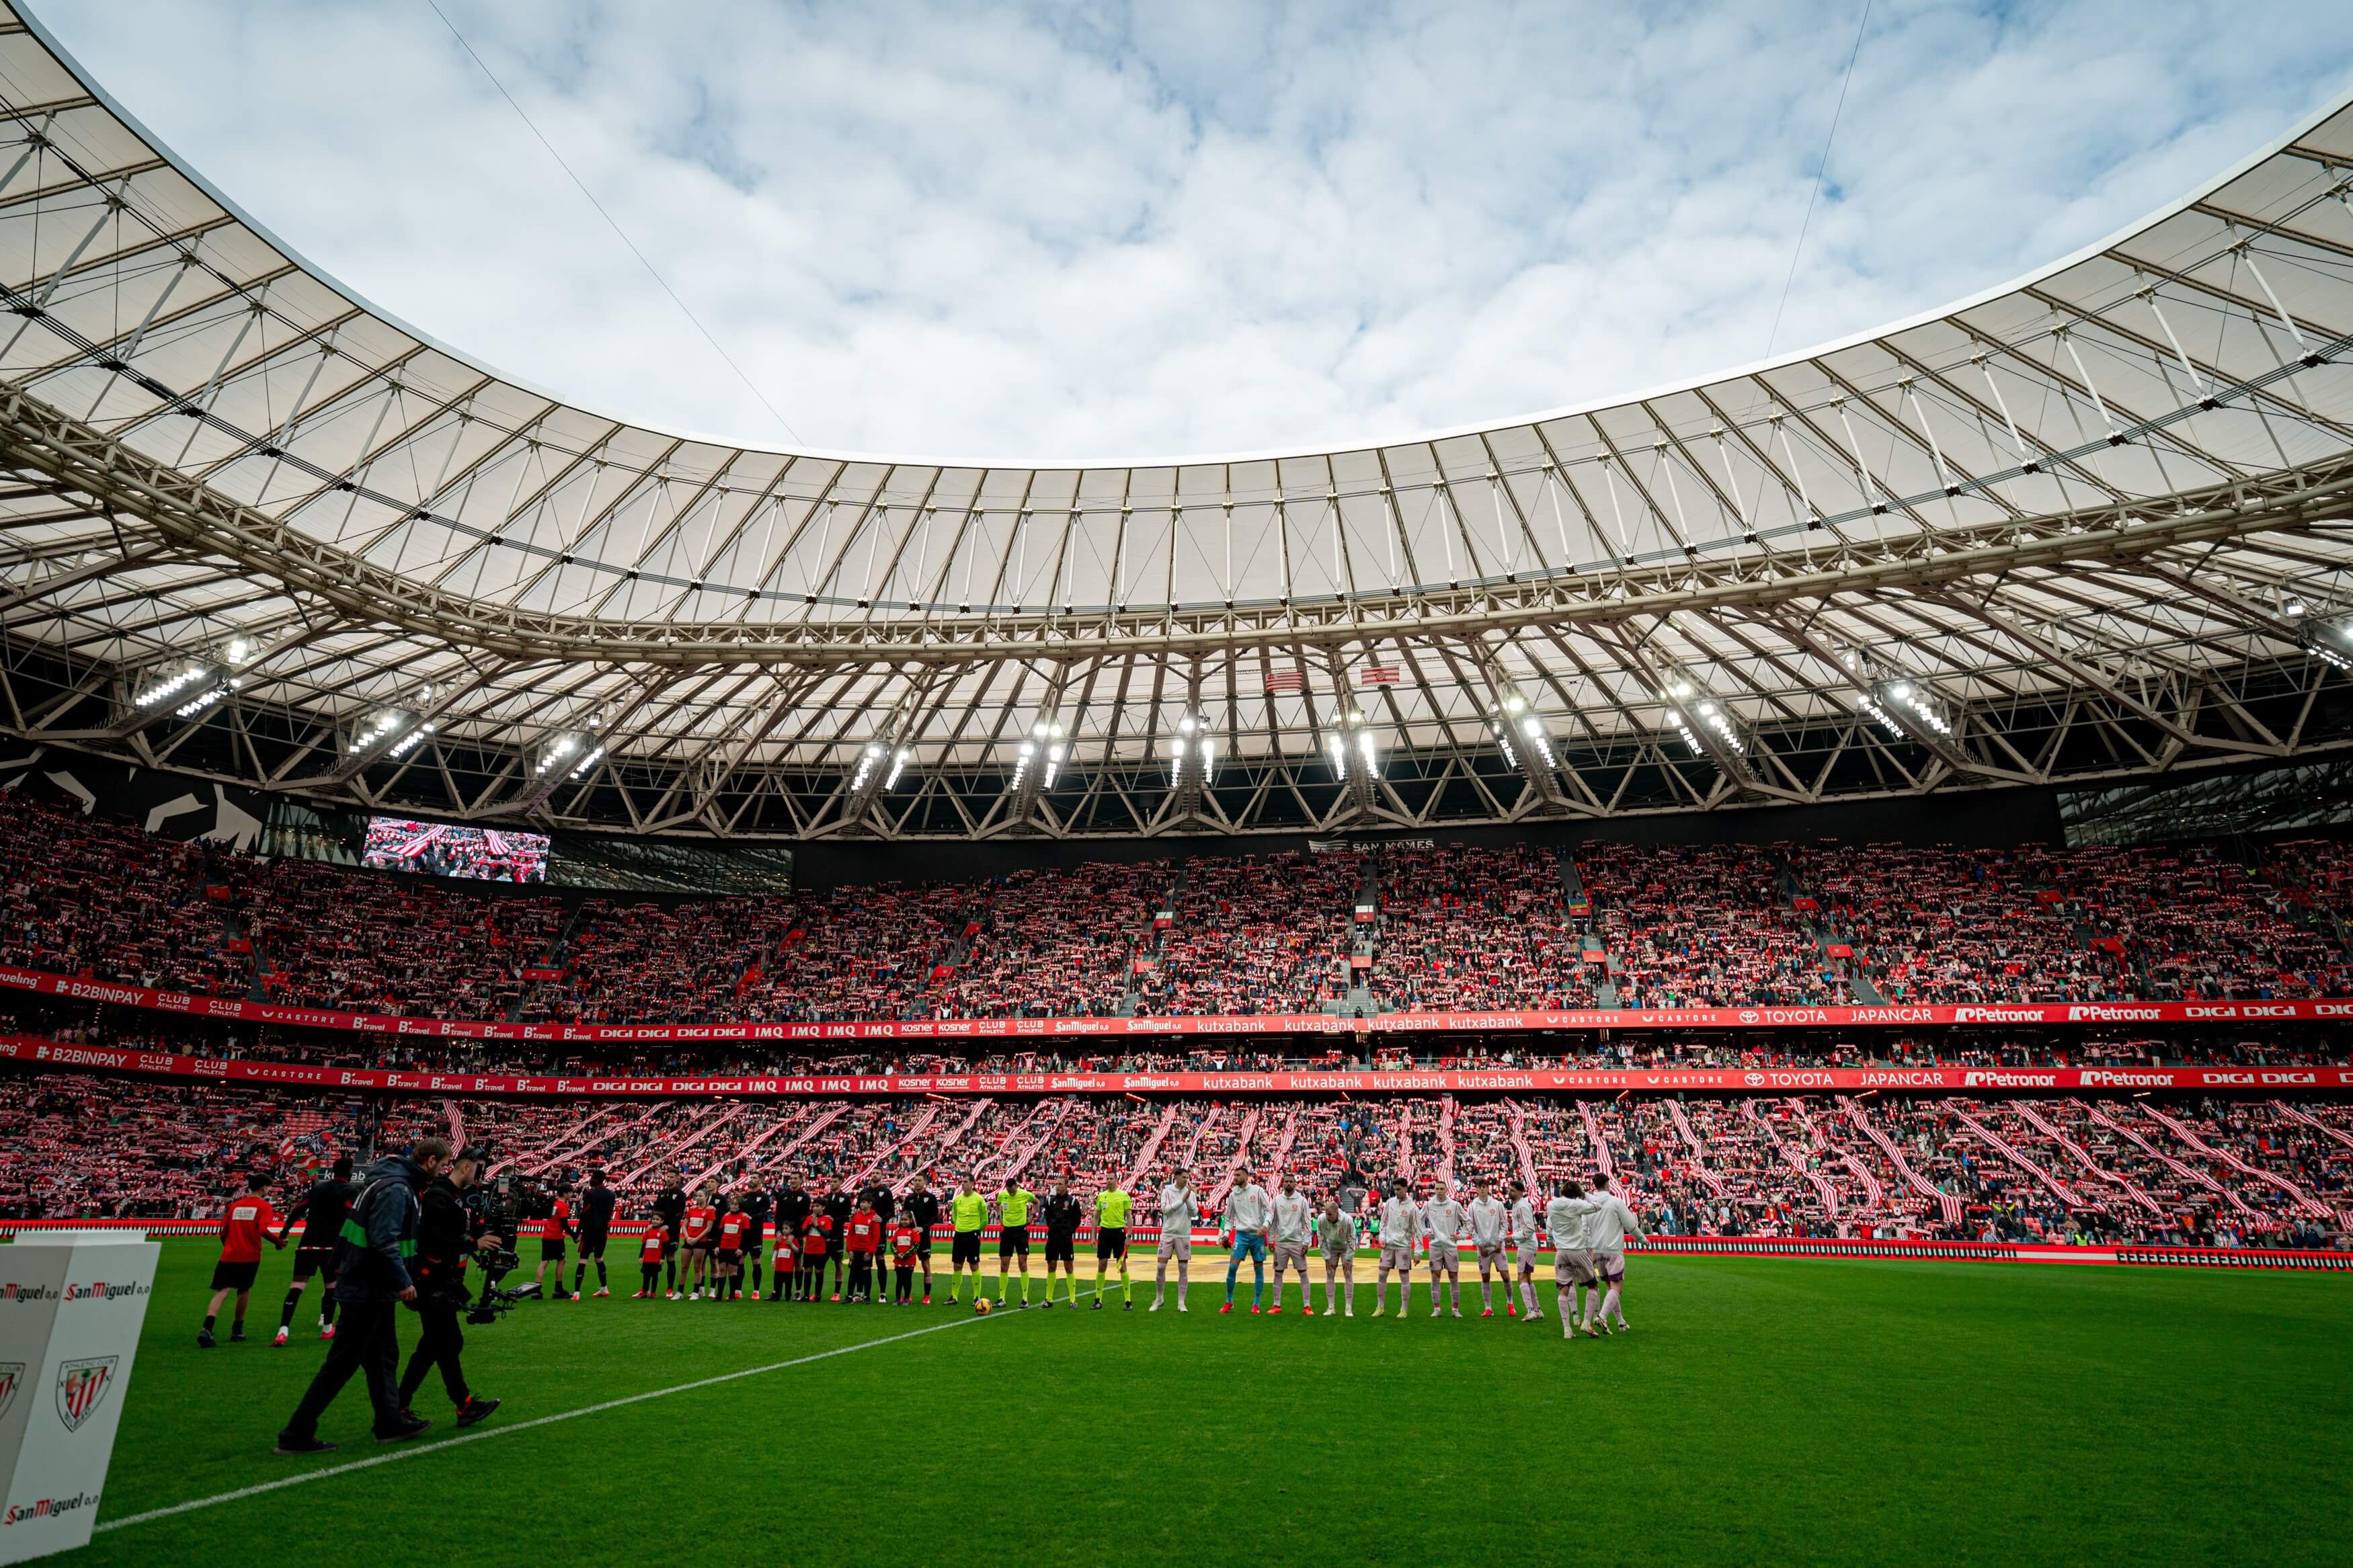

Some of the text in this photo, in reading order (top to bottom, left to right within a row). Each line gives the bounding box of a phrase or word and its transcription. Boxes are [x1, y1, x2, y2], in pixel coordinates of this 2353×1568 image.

[1353, 843, 1379, 852] SAN
[71, 983, 143, 1005] B2BINPAY
[157, 993, 190, 1005] CLUB
[156, 1001, 188, 1011] ATHLETIC
[209, 1000, 242, 1012] CLUB
[2243, 1005, 2297, 1016] DIGI
[2315, 1005, 2353, 1016] DIG
[208, 1008, 240, 1017] ATHLETIC
[1764, 1010, 1827, 1022] TOYOTA
[1851, 1009, 1933, 1022] JAPANCAR
[1976, 1008, 2044, 1022] Petronor
[2089, 1006, 2161, 1020] Petronor
[2185, 1007, 2237, 1017] DIGI
[278, 1012, 335, 1024] CASTORE
[1367, 1017, 1440, 1030] kutxabank
[1449, 1015, 1523, 1029] kutxabank
[1562, 1016, 1619, 1024] CASTORE
[1658, 1014, 1716, 1022] CASTORE
[865, 1025, 894, 1036] IMQ
[979, 1021, 1006, 1029] CLUB
[1197, 1020, 1266, 1032] kutxabank
[1285, 1019, 1355, 1032] kutxabank
[600, 1030, 633, 1038] DIGI
[637, 1030, 670, 1038] DIGI
[677, 1028, 710, 1037] DIGI
[713, 1028, 746, 1036] DIGI
[755, 1027, 784, 1038] IMQ
[791, 1026, 820, 1037] IMQ
[827, 1026, 856, 1037] IMQ
[52, 1048, 127, 1067] B2BINPAY
[140, 1055, 173, 1065] CLUB
[138, 1063, 171, 1071] ATHLETIC
[194, 1060, 227, 1070] CLUB
[194, 1067, 225, 1076] ATHLETIC
[263, 1069, 322, 1080] CASTORE
[1203, 1075, 1273, 1089] kutxabank
[1291, 1075, 1362, 1088] kutxabank
[1373, 1075, 1447, 1088] kutxabank
[1458, 1074, 1533, 1087] kutxabank
[1569, 1076, 1627, 1084] CASTORE
[1770, 1073, 1834, 1085] TOYOTA
[1861, 1073, 1944, 1085] JAPANCAR
[1986, 1071, 2056, 1086] Petronor
[2102, 1071, 2174, 1085] Petronor
[2202, 1073, 2255, 1083] DIGI
[2261, 1073, 2316, 1083] DIGI
[592, 1082, 626, 1091] DIGI
[630, 1082, 664, 1091] DIGI
[672, 1082, 705, 1091] DIGI
[709, 1082, 742, 1091] DIGI
[748, 1081, 778, 1092] IMQ
[785, 1080, 814, 1092] IMQ
[822, 1080, 851, 1091] IMQ
[859, 1079, 889, 1091] IMQ
[0, 1284, 45, 1303] nMiguel
[65, 1281, 135, 1301] SanMiguel
[5, 1491, 83, 1525] SanMiguel
